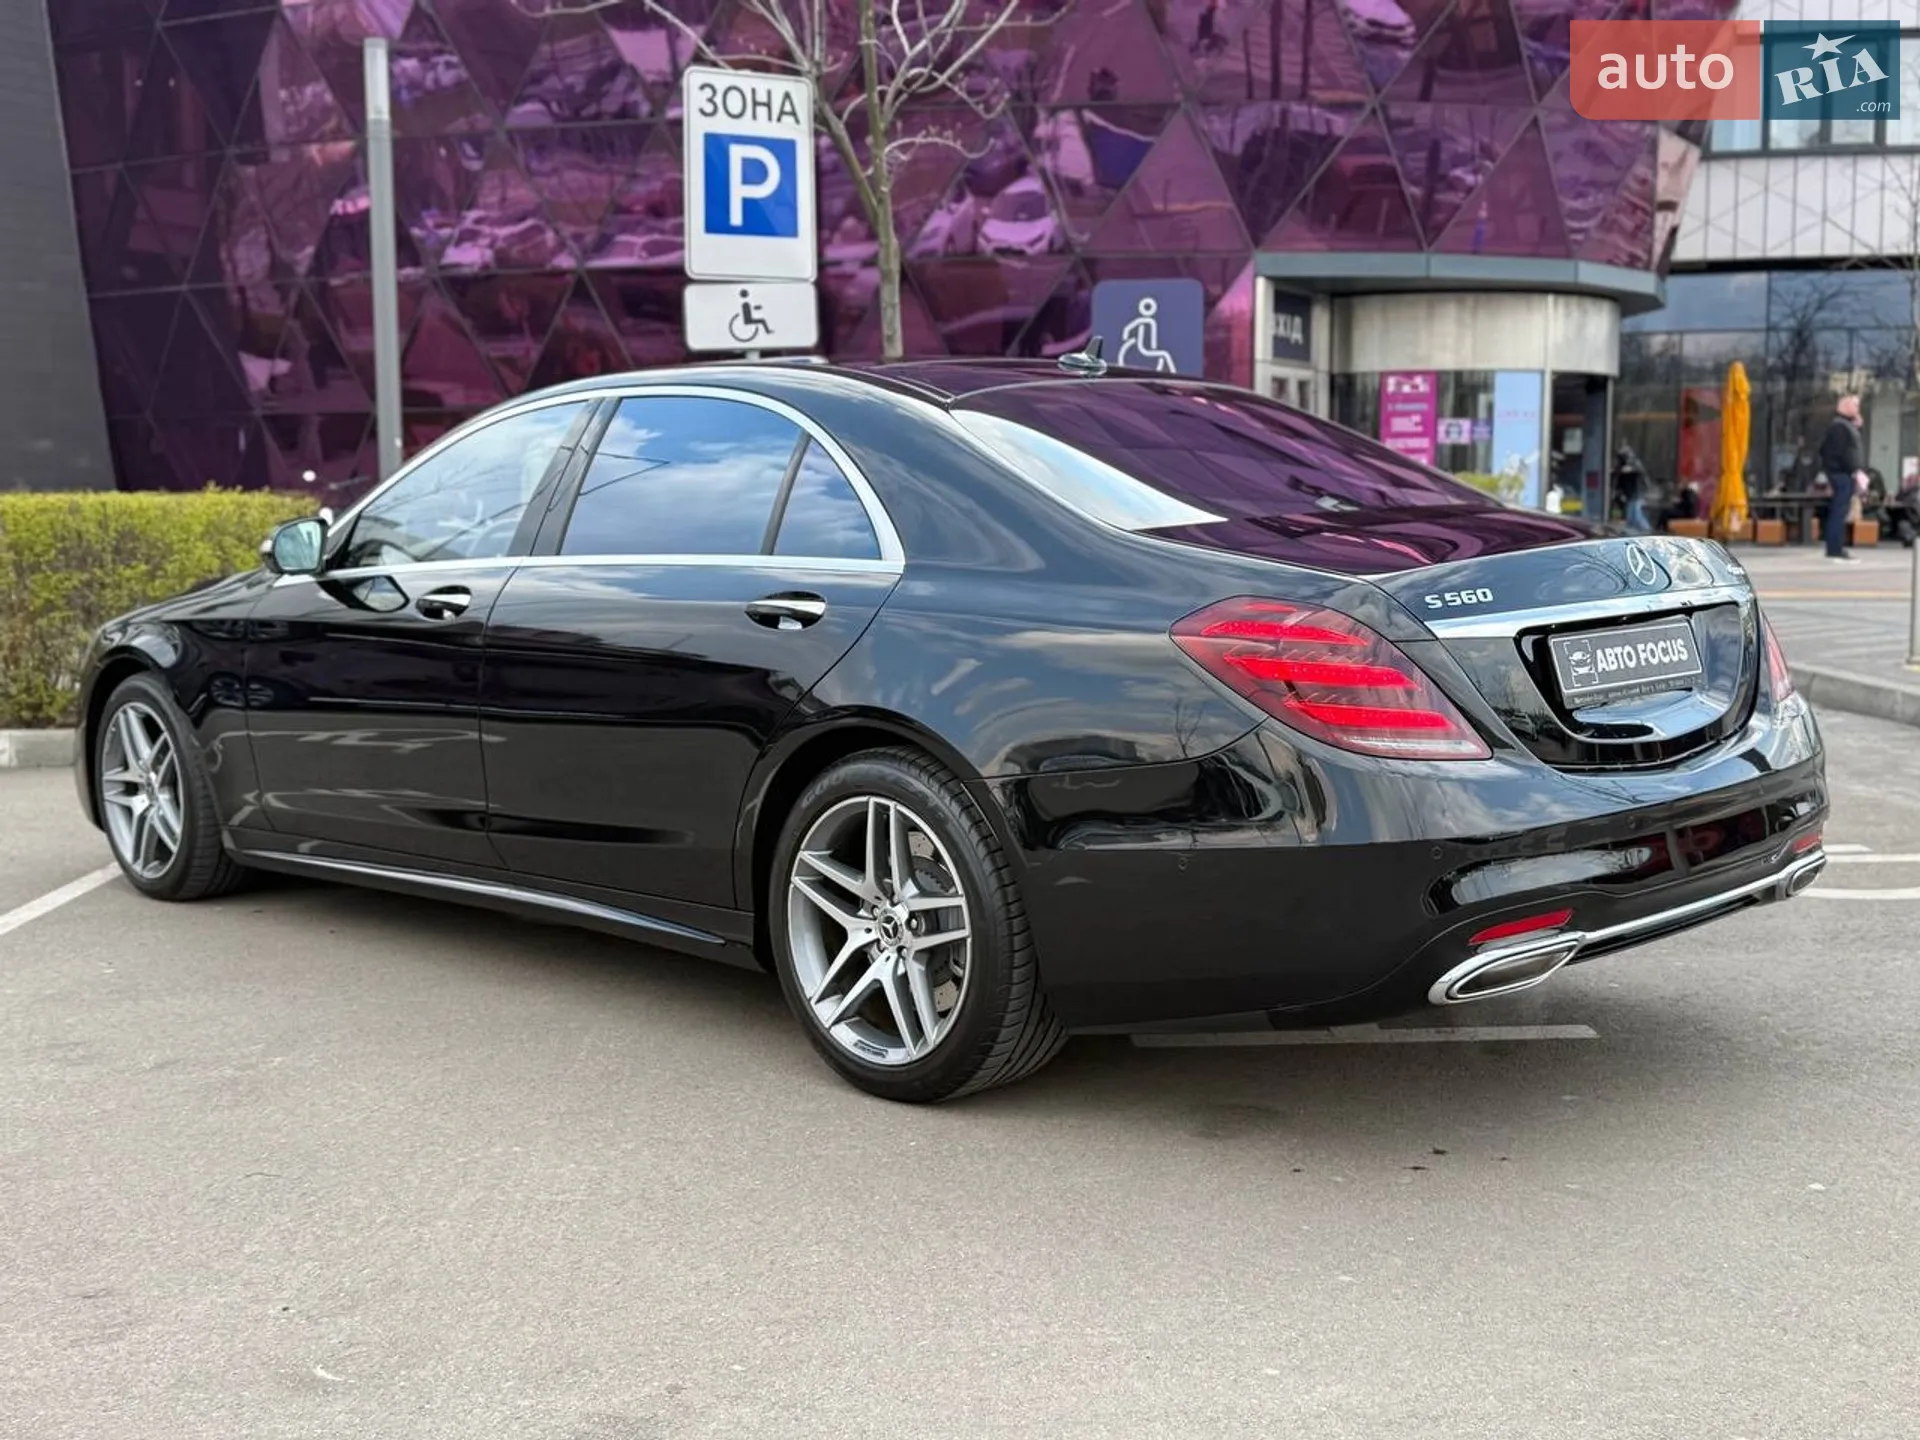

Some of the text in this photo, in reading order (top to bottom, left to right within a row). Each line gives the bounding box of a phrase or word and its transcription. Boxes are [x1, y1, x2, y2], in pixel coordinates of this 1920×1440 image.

[698, 82, 801, 126] ЗОНА
[729, 143, 782, 227] P
[1273, 312, 1304, 345] ХІД
[1424, 587, 1494, 609] S 560
[1596, 637, 1689, 673] АВТО FOCUS
